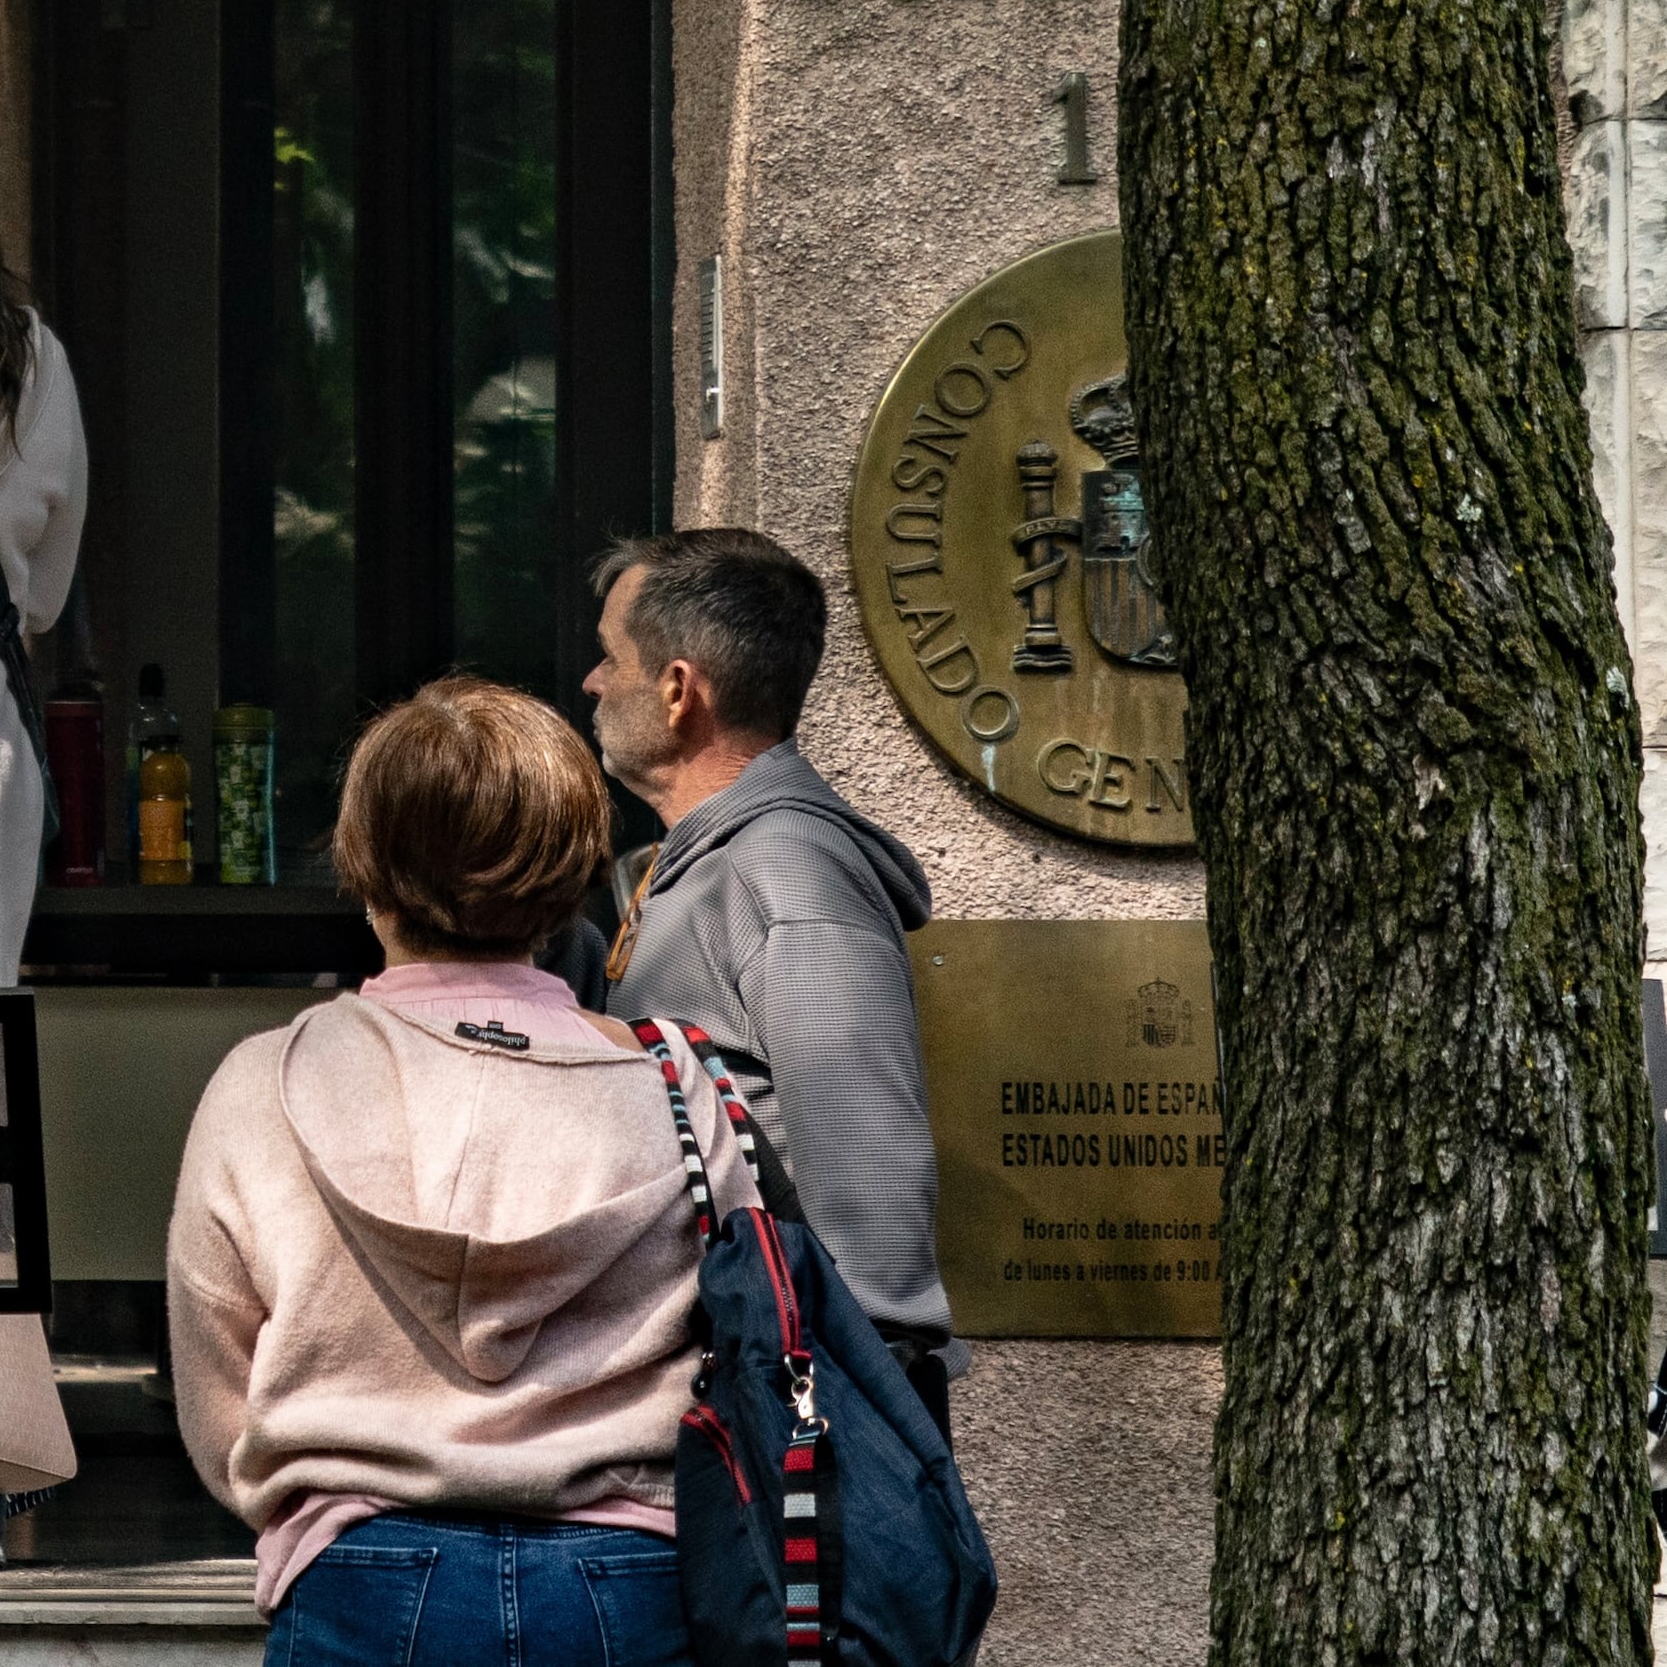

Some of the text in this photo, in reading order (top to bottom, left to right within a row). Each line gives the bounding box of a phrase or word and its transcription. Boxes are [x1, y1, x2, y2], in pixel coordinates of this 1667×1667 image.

[884, 319, 1032, 744] CONSULADO
[1001, 1082, 1116, 1116] EMBAJADA
[1123, 1081, 1149, 1115] DE
[1001, 1133, 1100, 1167] ESTADOS
[1109, 1133, 1188, 1167] UNIDOS
[1023, 1218, 1089, 1241] Horario
[1095, 1218, 1118, 1240] de
[1124, 1216, 1202, 1241] atención
[1004, 1259, 1022, 1281] de
[1027, 1259, 1068, 1282] lunes
[1075, 1263, 1085, 1282] a
[1089, 1259, 1148, 1282] viernes
[1152, 1259, 1172, 1282] de
[1177, 1259, 1210, 1282] 9:00
